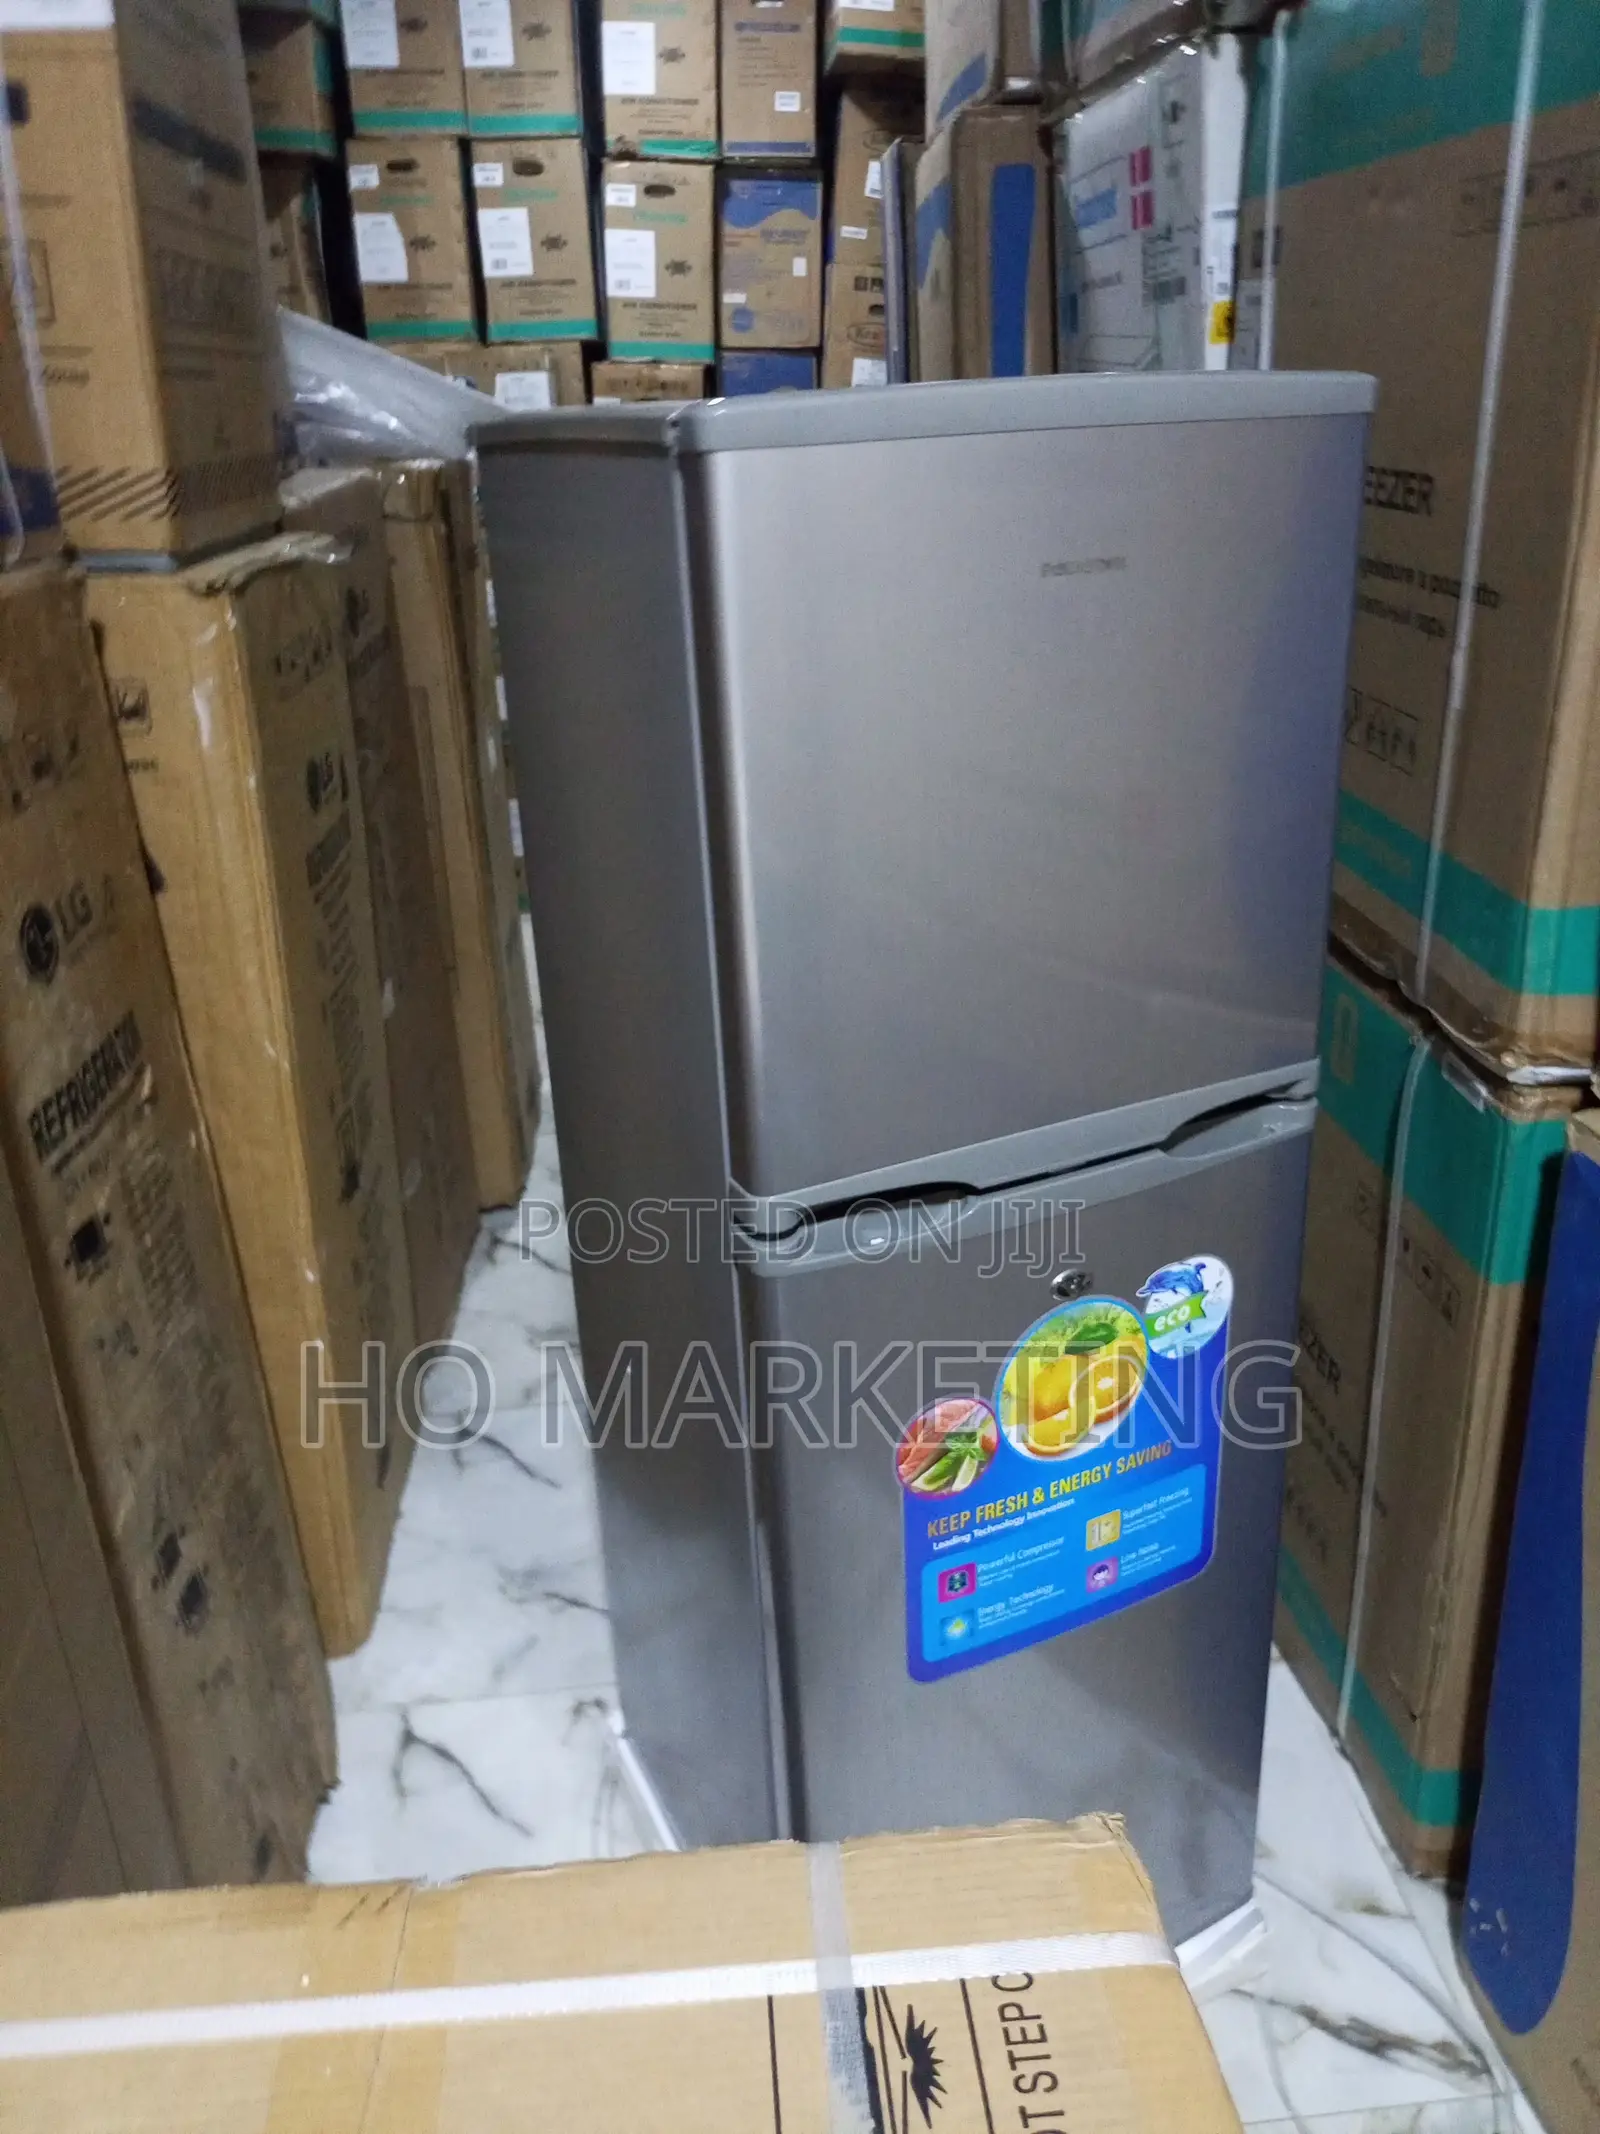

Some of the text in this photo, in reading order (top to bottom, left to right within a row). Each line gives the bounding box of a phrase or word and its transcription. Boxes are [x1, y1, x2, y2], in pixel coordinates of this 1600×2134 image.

[1153, 1304, 1191, 1333] eco
[927, 1439, 1173, 1539] KEEP FRESH & ENERGY SAVING
[997, 2001, 1059, 2094] STEP
